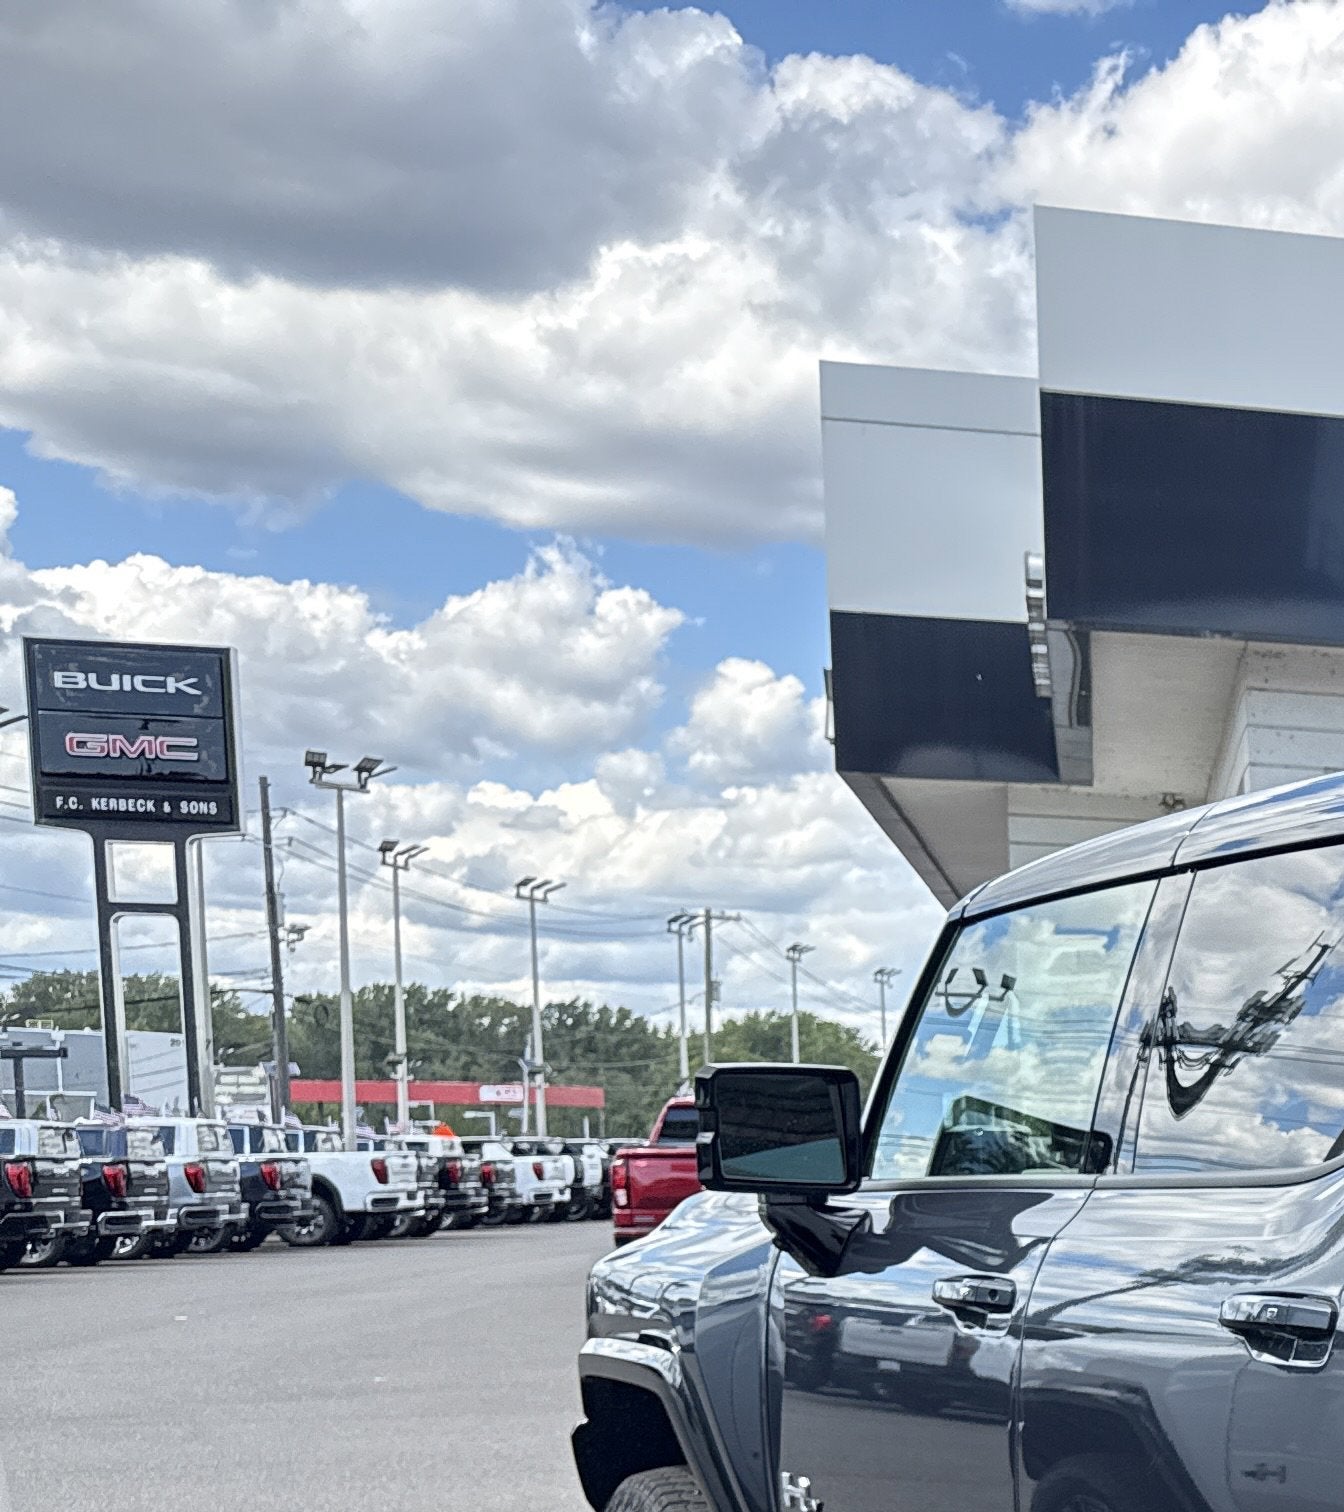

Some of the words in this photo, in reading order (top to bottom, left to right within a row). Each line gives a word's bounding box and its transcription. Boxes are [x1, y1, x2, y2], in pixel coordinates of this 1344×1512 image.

[53, 671, 202, 695] BUICK
[65, 732, 199, 761] GMC
[55, 796, 84, 810] F.C.
[91, 797, 156, 813] KERBECK
[163, 801, 171, 813] &
[180, 800, 218, 815] SONS
